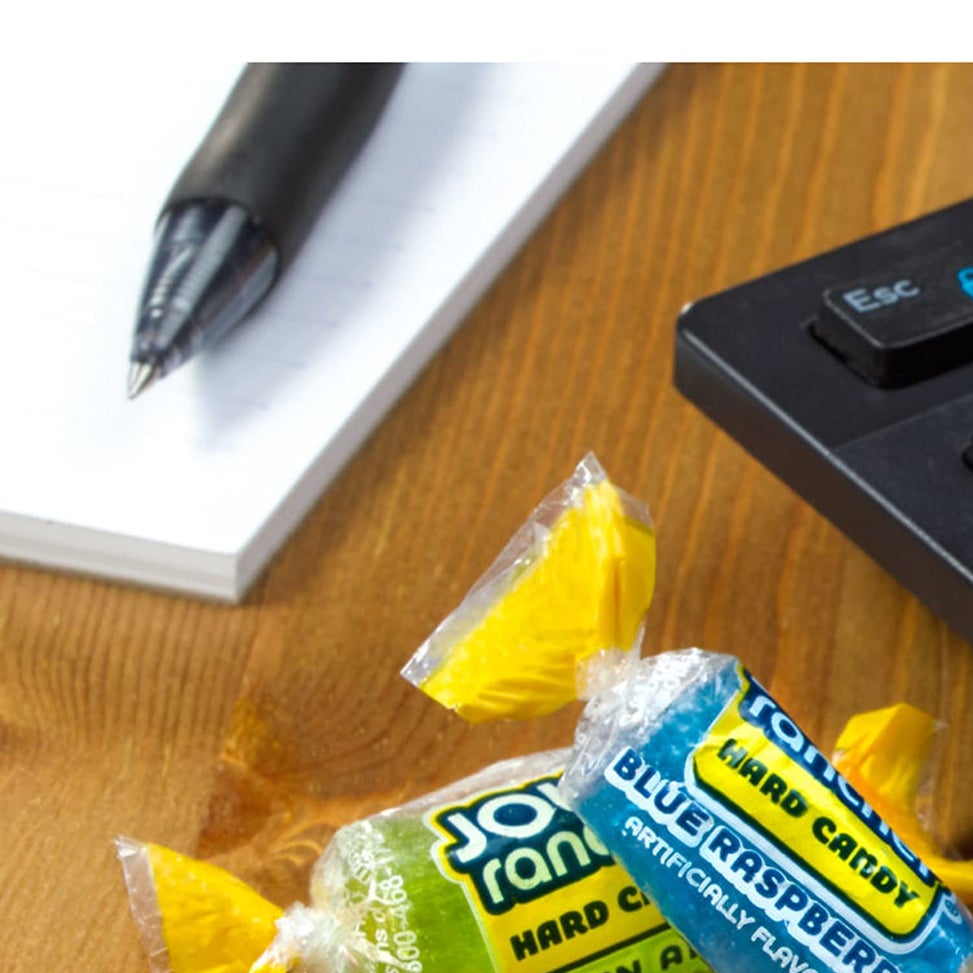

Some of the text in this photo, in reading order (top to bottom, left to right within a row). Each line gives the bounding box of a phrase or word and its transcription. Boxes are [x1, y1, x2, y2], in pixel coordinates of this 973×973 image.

[843, 280, 919, 312] Esc
[613, 748, 710, 837] BLUE
[717, 738, 919, 908] HARD CANDY
[622, 816, 755, 930] ARTIFICIALLY
[509, 900, 609, 961] HARD
